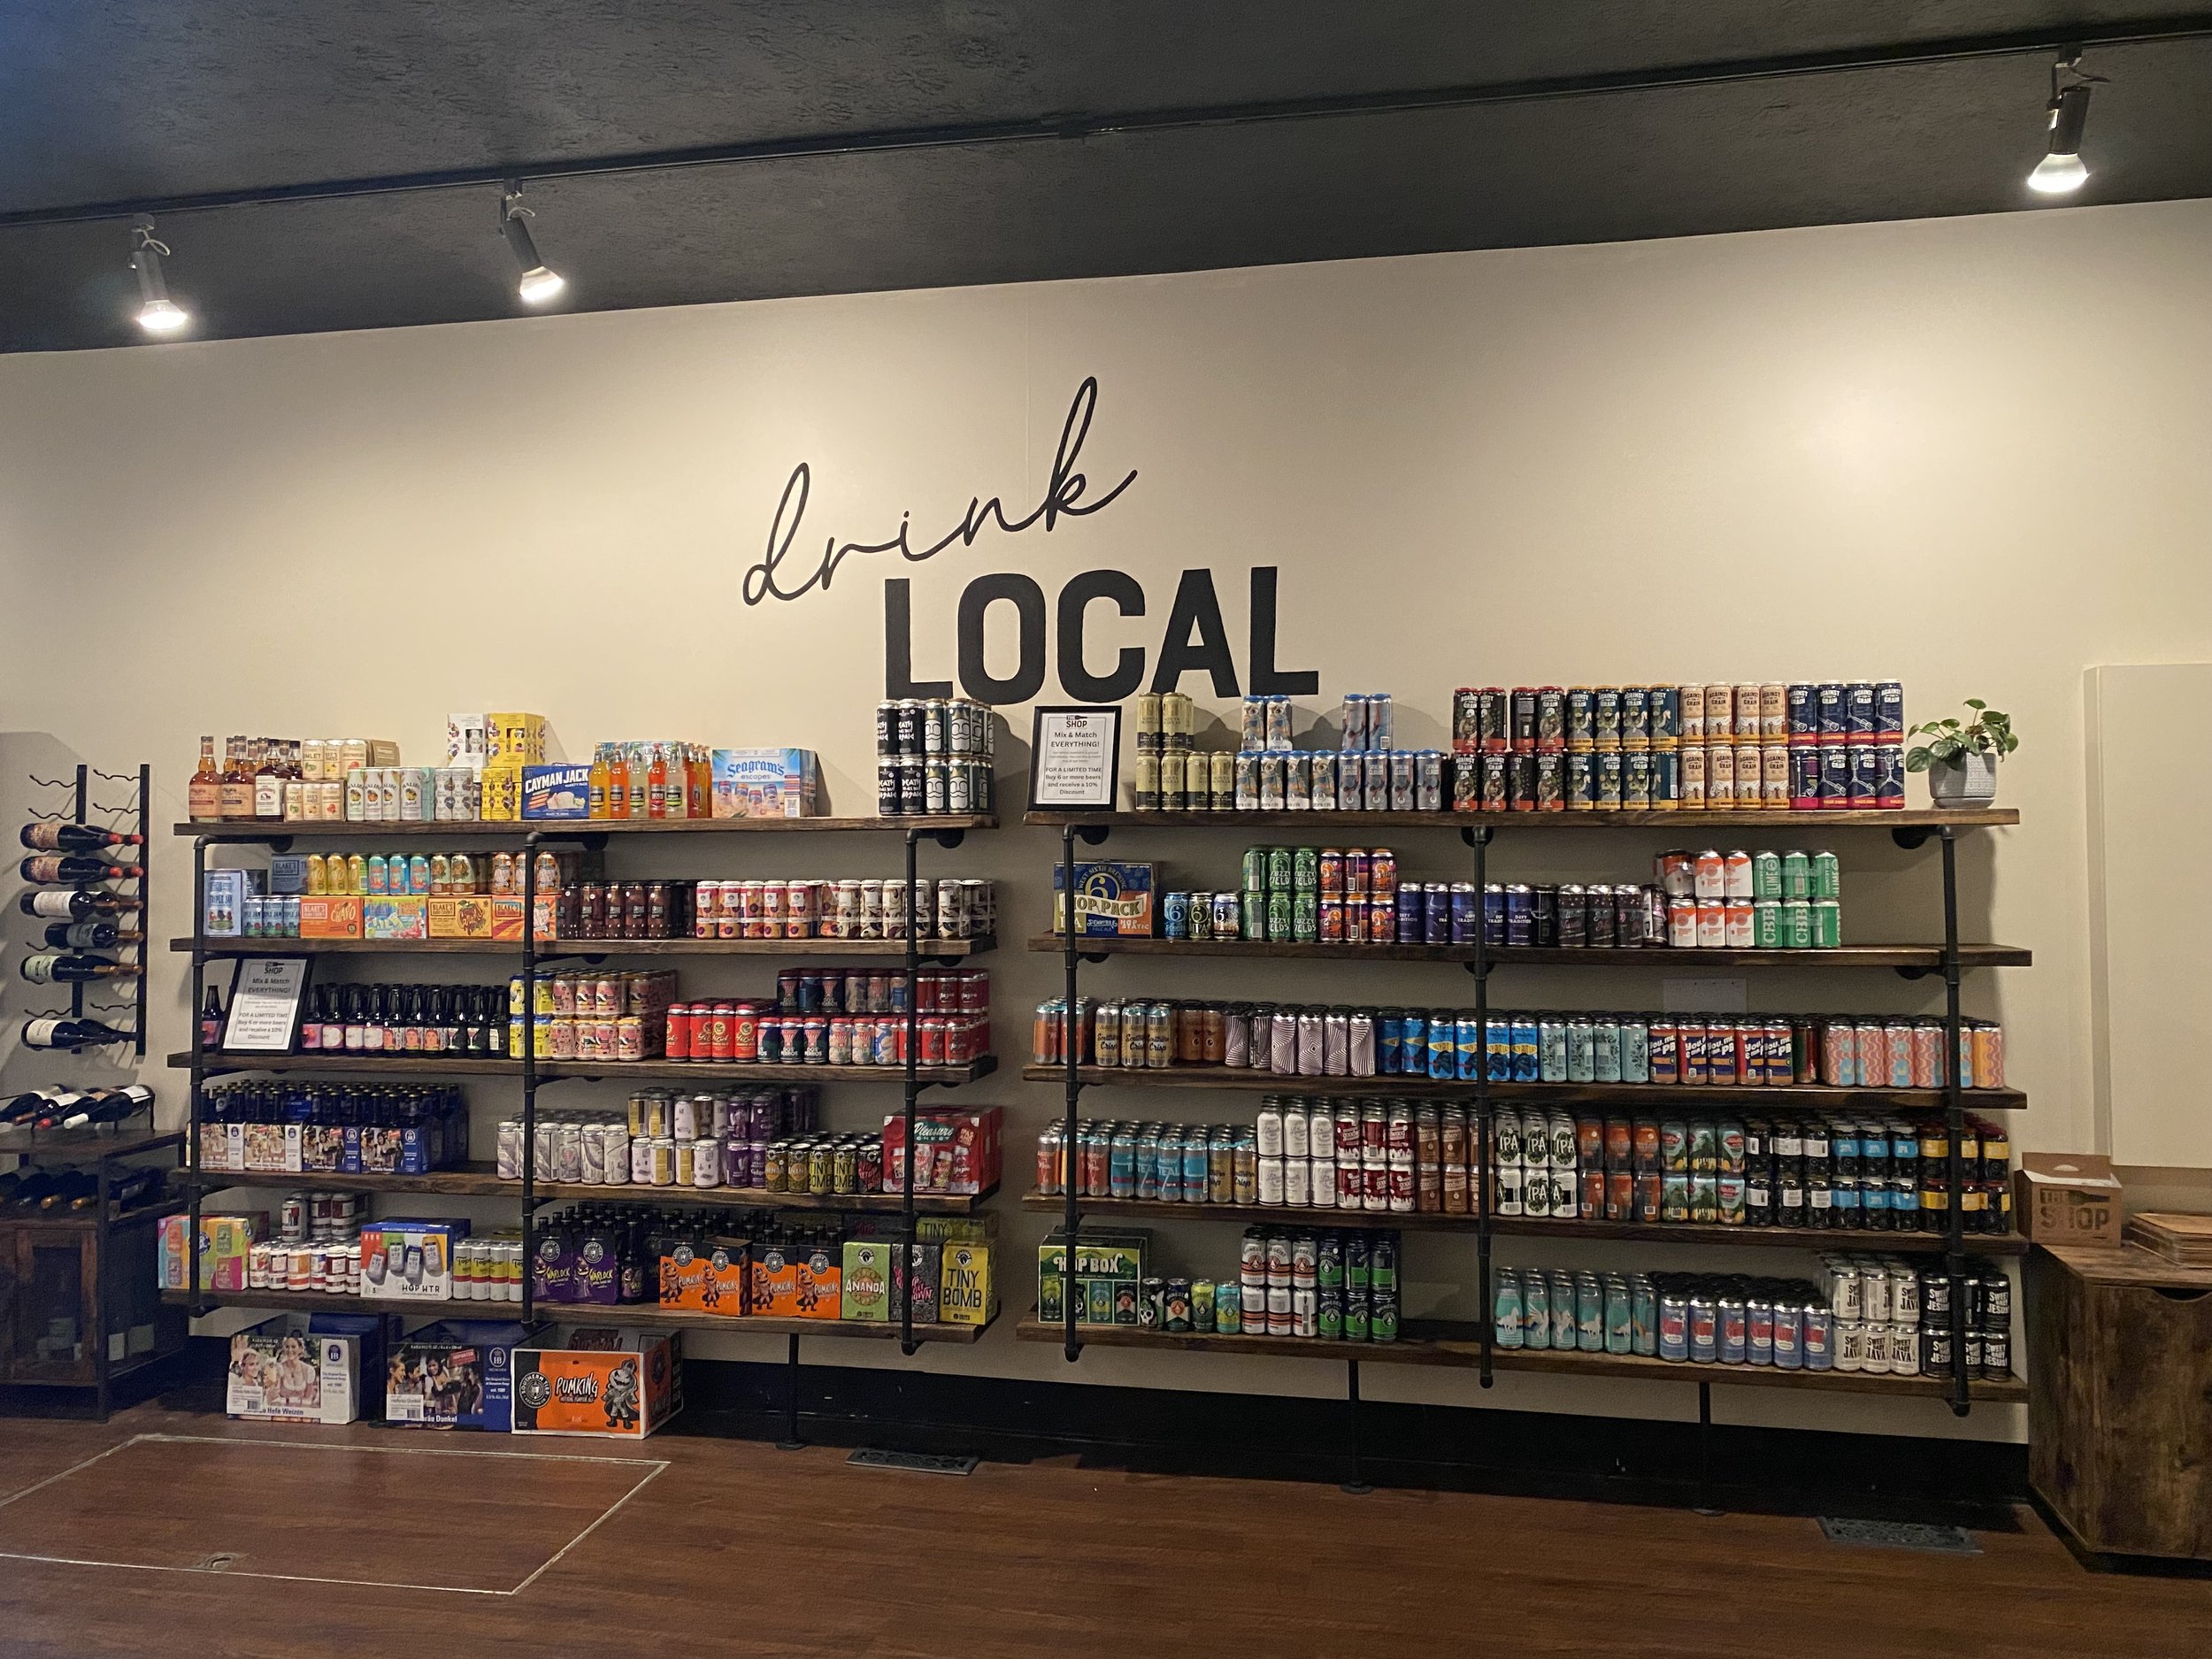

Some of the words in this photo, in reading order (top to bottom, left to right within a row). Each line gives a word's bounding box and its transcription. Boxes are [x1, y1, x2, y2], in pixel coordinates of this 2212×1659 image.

[742, 376, 1139, 607] drink
[885, 566, 1320, 705] LOCAL
[726, 761, 784, 778] Seagram's
[525, 771, 562, 794] CAYMAN
[563, 769, 589, 783] JACK
[1074, 897, 1097, 911] OP
[1101, 900, 1140, 916] PACK
[1193, 923, 1207, 933] IPA
[1763, 908, 1775, 943] CBB
[1796, 908, 1807, 943] CBB
[1149, 1042, 1167, 1051] Crisp
[1662, 1042, 1675, 1055] PB
[1722, 1043, 1734, 1055] PB
[1778, 1043, 1791, 1056] PB
[915, 1122, 954, 1136] Pleasure
[1500, 1137, 1518, 1151] IPA
[1528, 1137, 1545, 1151] IPA
[1557, 1138, 1575, 1151] IPA
[1528, 1185, 1546, 1200] IPA
[923, 1223, 947, 1237] TINY
[1053, 1257, 1087, 1272] HP
[1090, 1253, 1123, 1273] BOX
[947, 1269, 979, 1288] TINY
[846, 1279, 885, 1294] ANANDA
[944, 1288, 982, 1308] BOMB
[1867, 1337, 1885, 1346] SWEET
[1893, 1337, 1910, 1346] SWEET
[1986, 1343, 2006, 1353] SWEET
[521, 1374, 544, 1394] SOUTHERN
[556, 1372, 598, 1397] PUMKING
